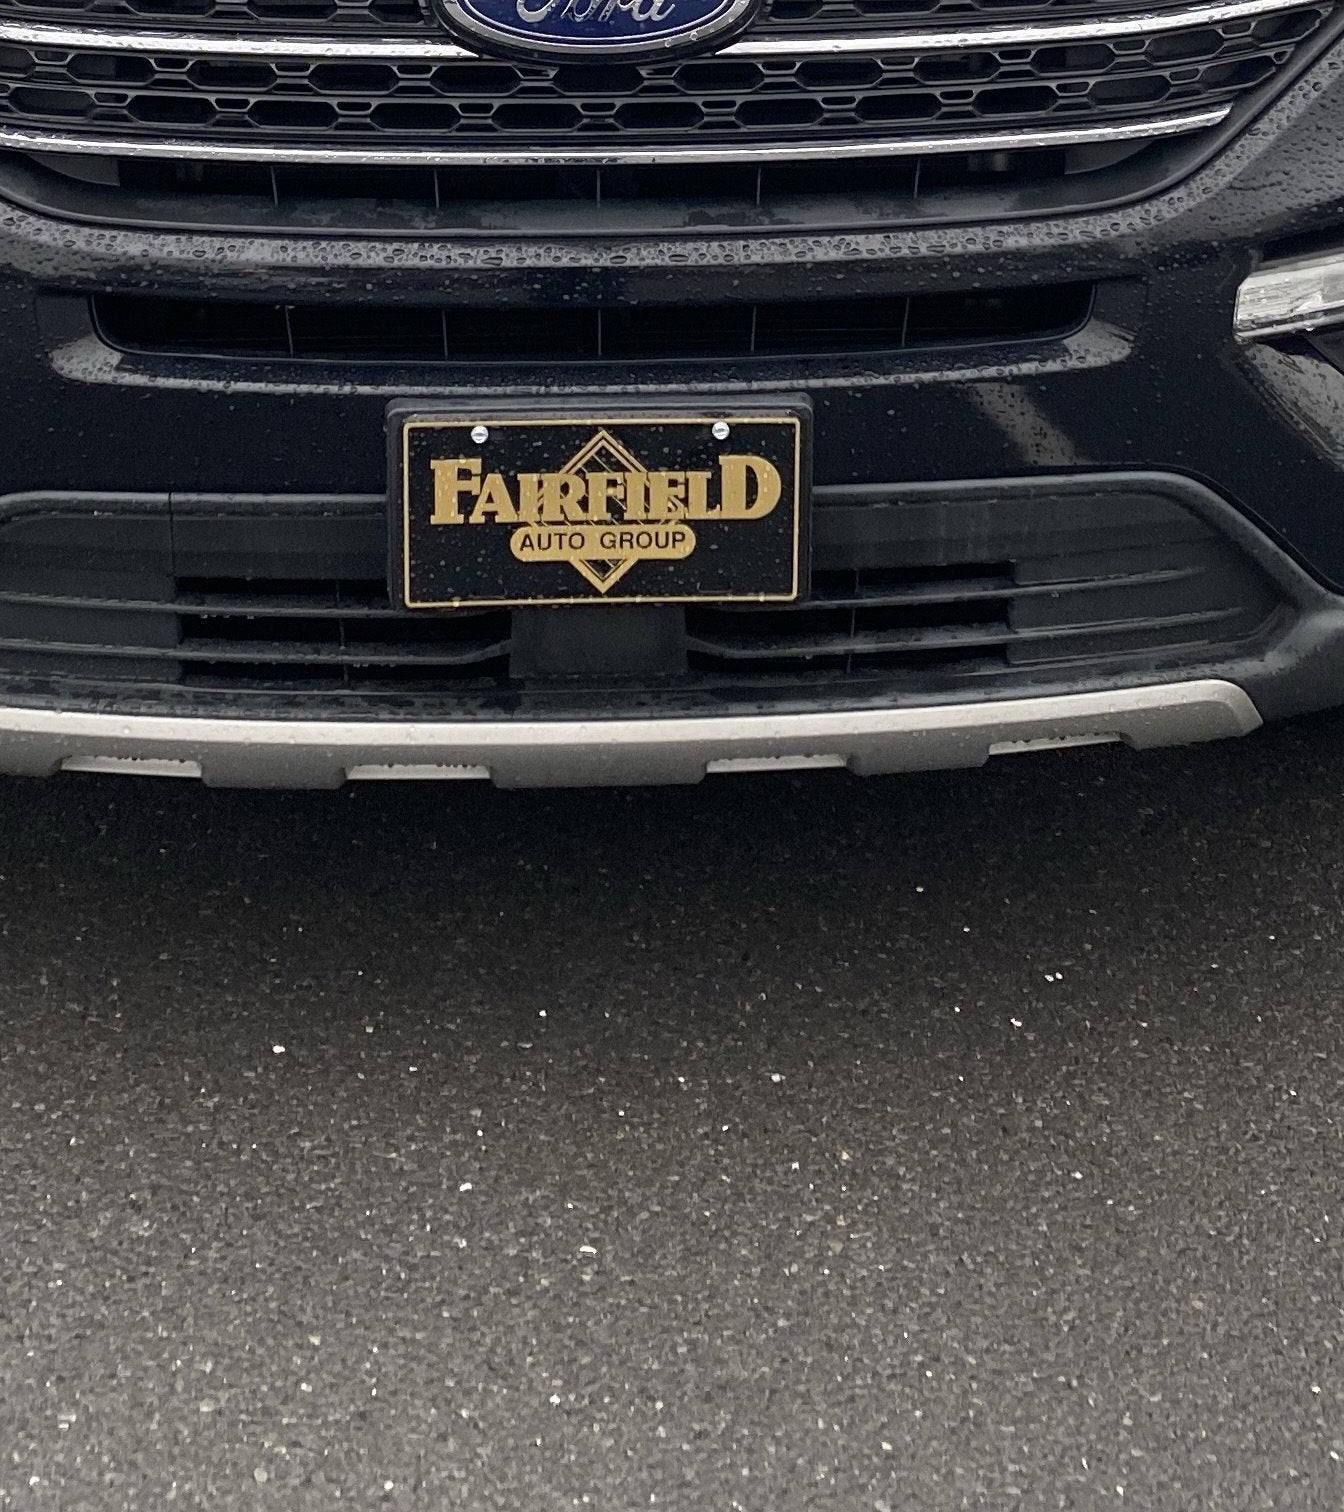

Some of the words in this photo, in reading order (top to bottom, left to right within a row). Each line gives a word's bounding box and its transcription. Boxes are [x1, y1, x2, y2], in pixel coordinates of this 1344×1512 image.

[430, 454, 782, 525] FAIRFIELD
[519, 532, 586, 552] AUTO
[599, 531, 687, 550] GROUP
